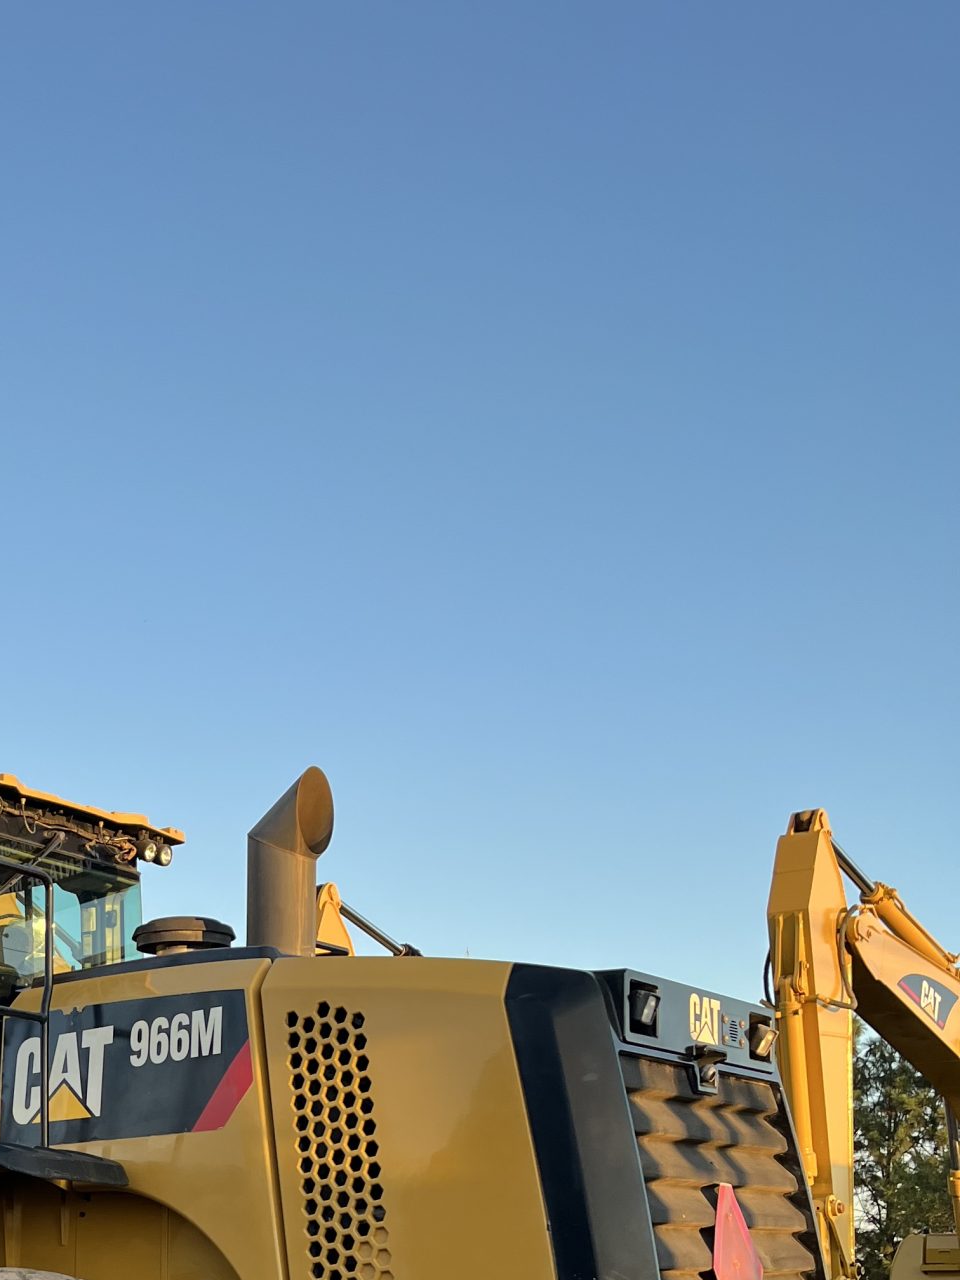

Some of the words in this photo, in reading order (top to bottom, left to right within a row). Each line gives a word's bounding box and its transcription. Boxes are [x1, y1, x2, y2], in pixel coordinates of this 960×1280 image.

[689, 993, 721, 1045] CAT
[920, 980, 942, 1022] CAT
[11, 1024, 115, 1126] CAT
[129, 1006, 223, 1067] 966M
